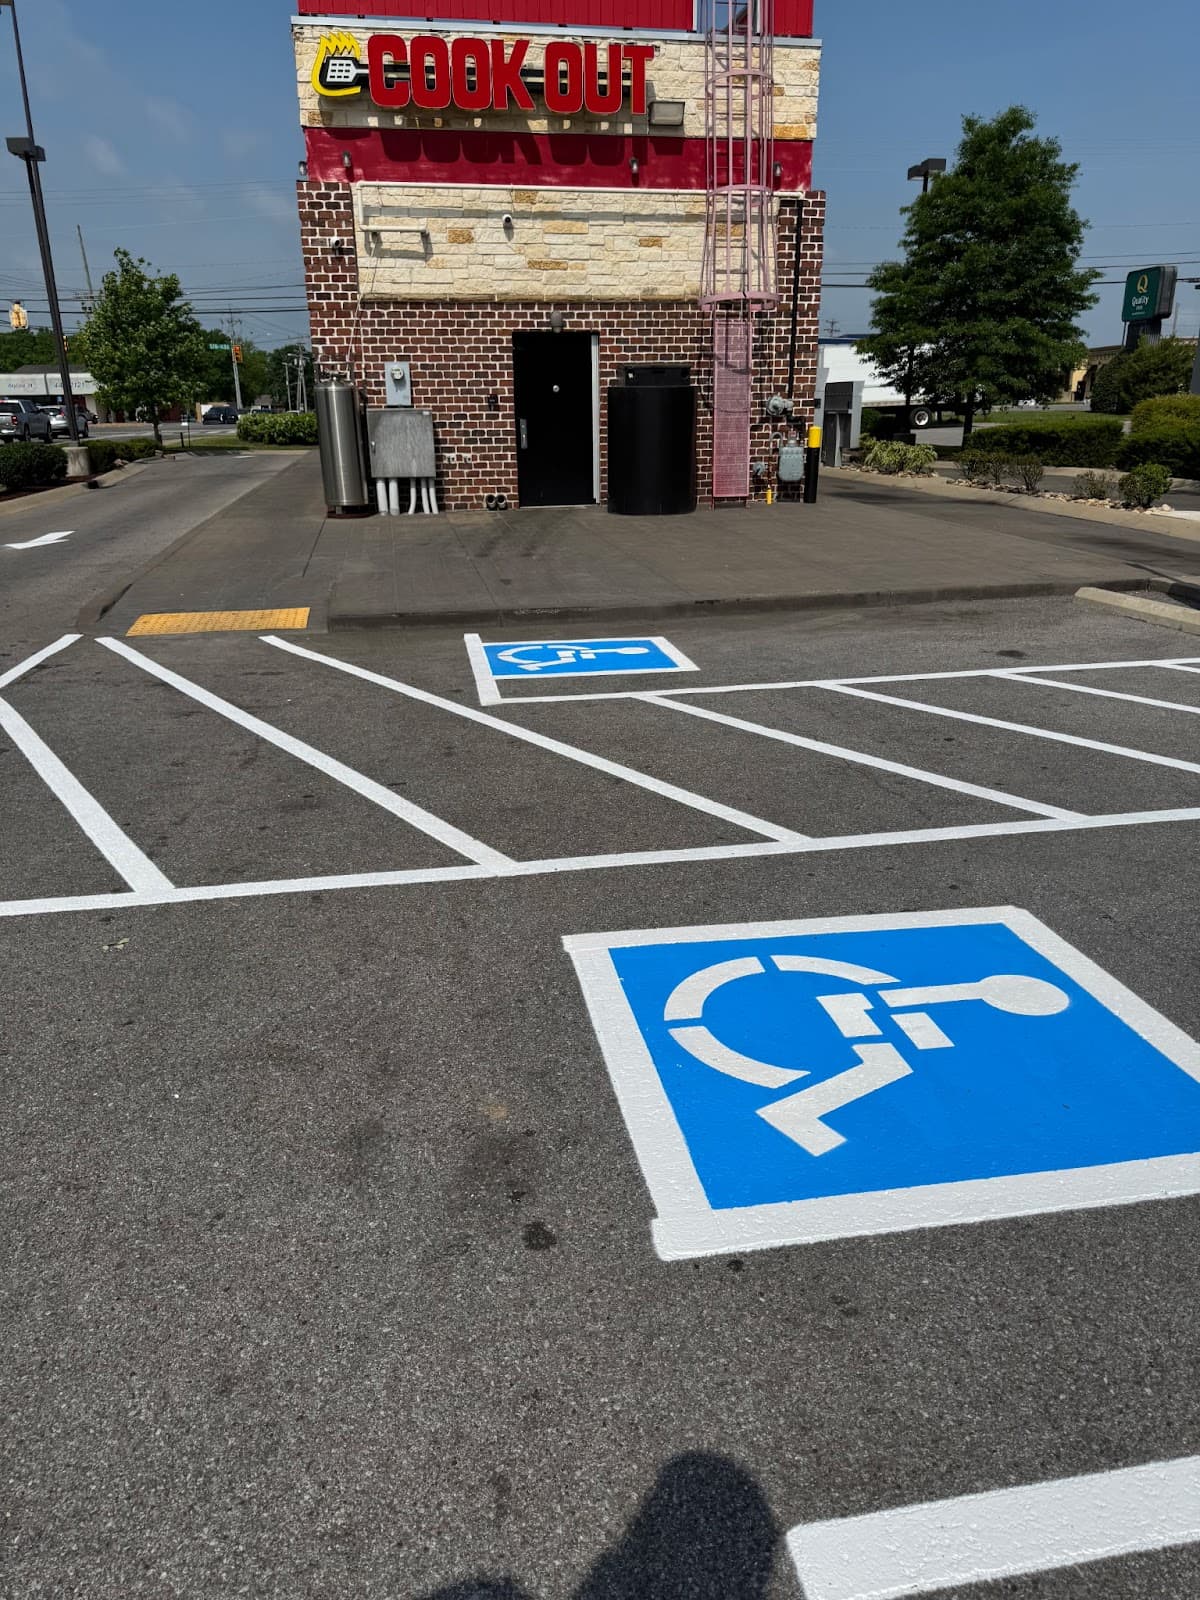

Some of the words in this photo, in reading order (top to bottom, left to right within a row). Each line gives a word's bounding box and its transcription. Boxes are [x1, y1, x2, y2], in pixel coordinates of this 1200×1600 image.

[367, 34, 535, 110] COOK
[544, 41, 655, 115] OUT
[1137, 274, 1148, 293] Q
